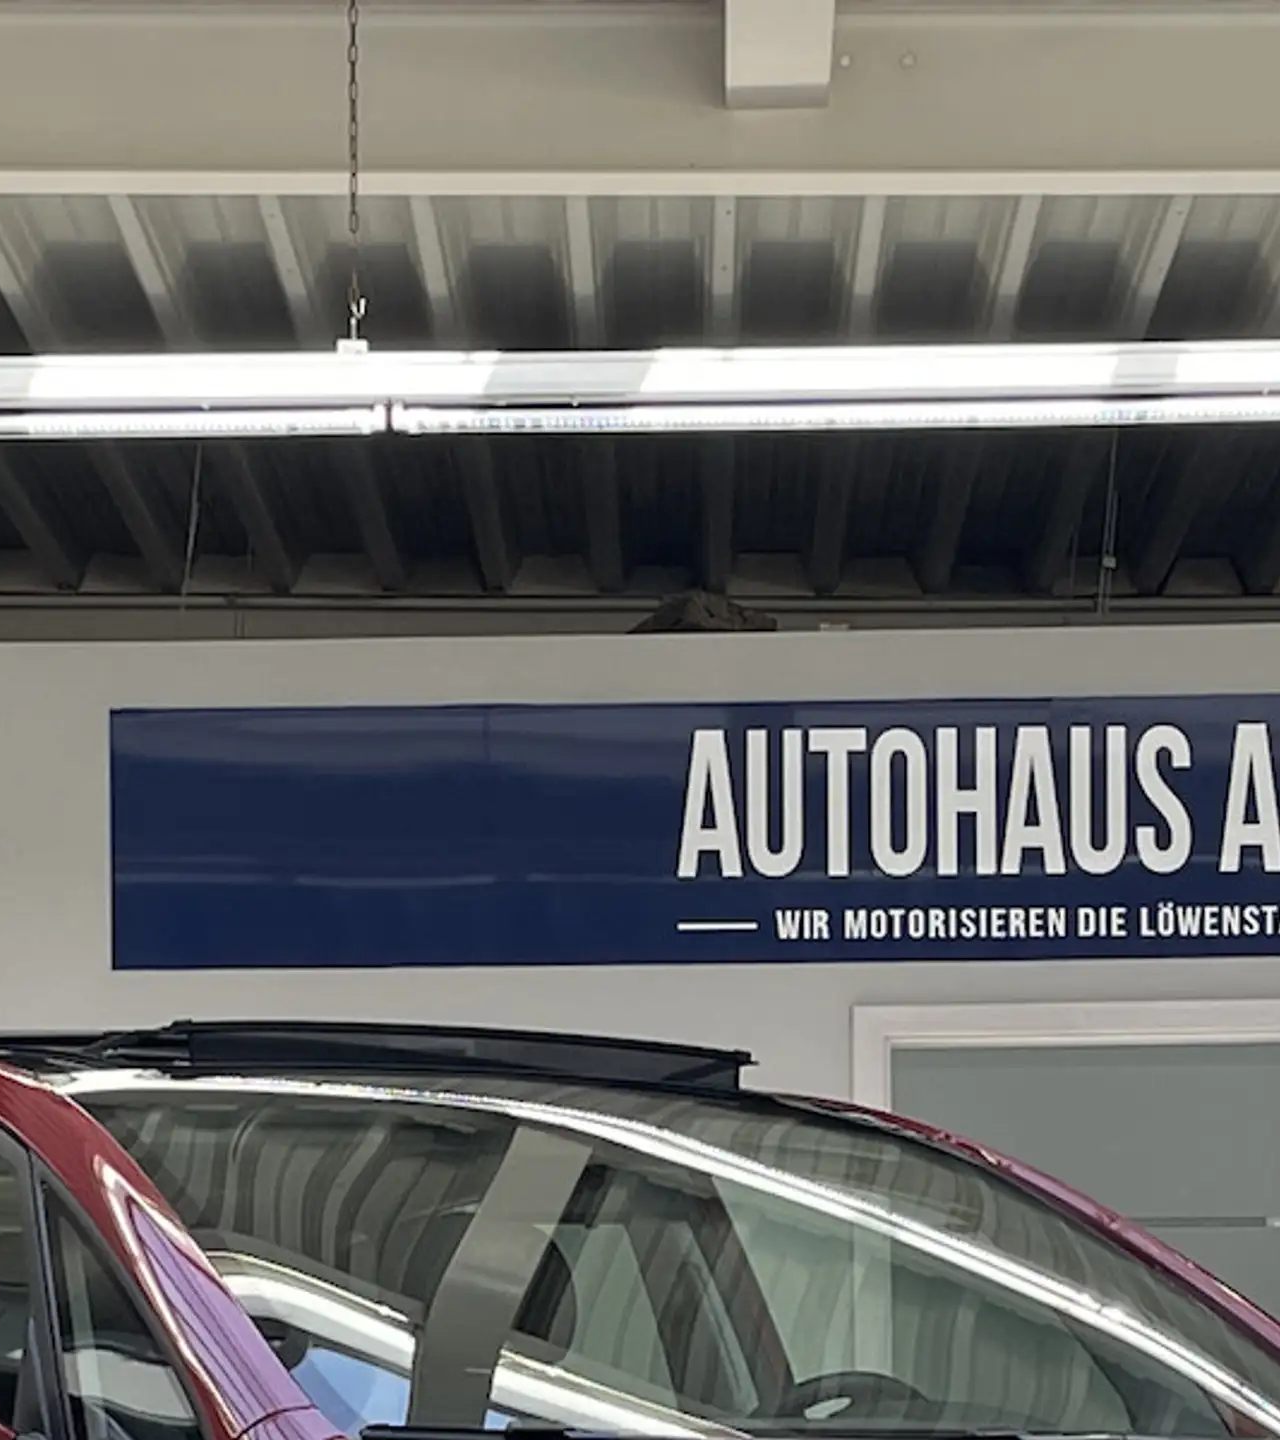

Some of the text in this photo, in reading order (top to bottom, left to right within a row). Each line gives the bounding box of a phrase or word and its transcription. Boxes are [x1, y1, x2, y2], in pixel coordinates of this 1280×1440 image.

[677, 724, 1192, 878] AUTOHAUS
[774, 909, 830, 940] WIR
[843, 906, 1066, 940] MOTORISIEREN
[1076, 906, 1128, 938] DIE
